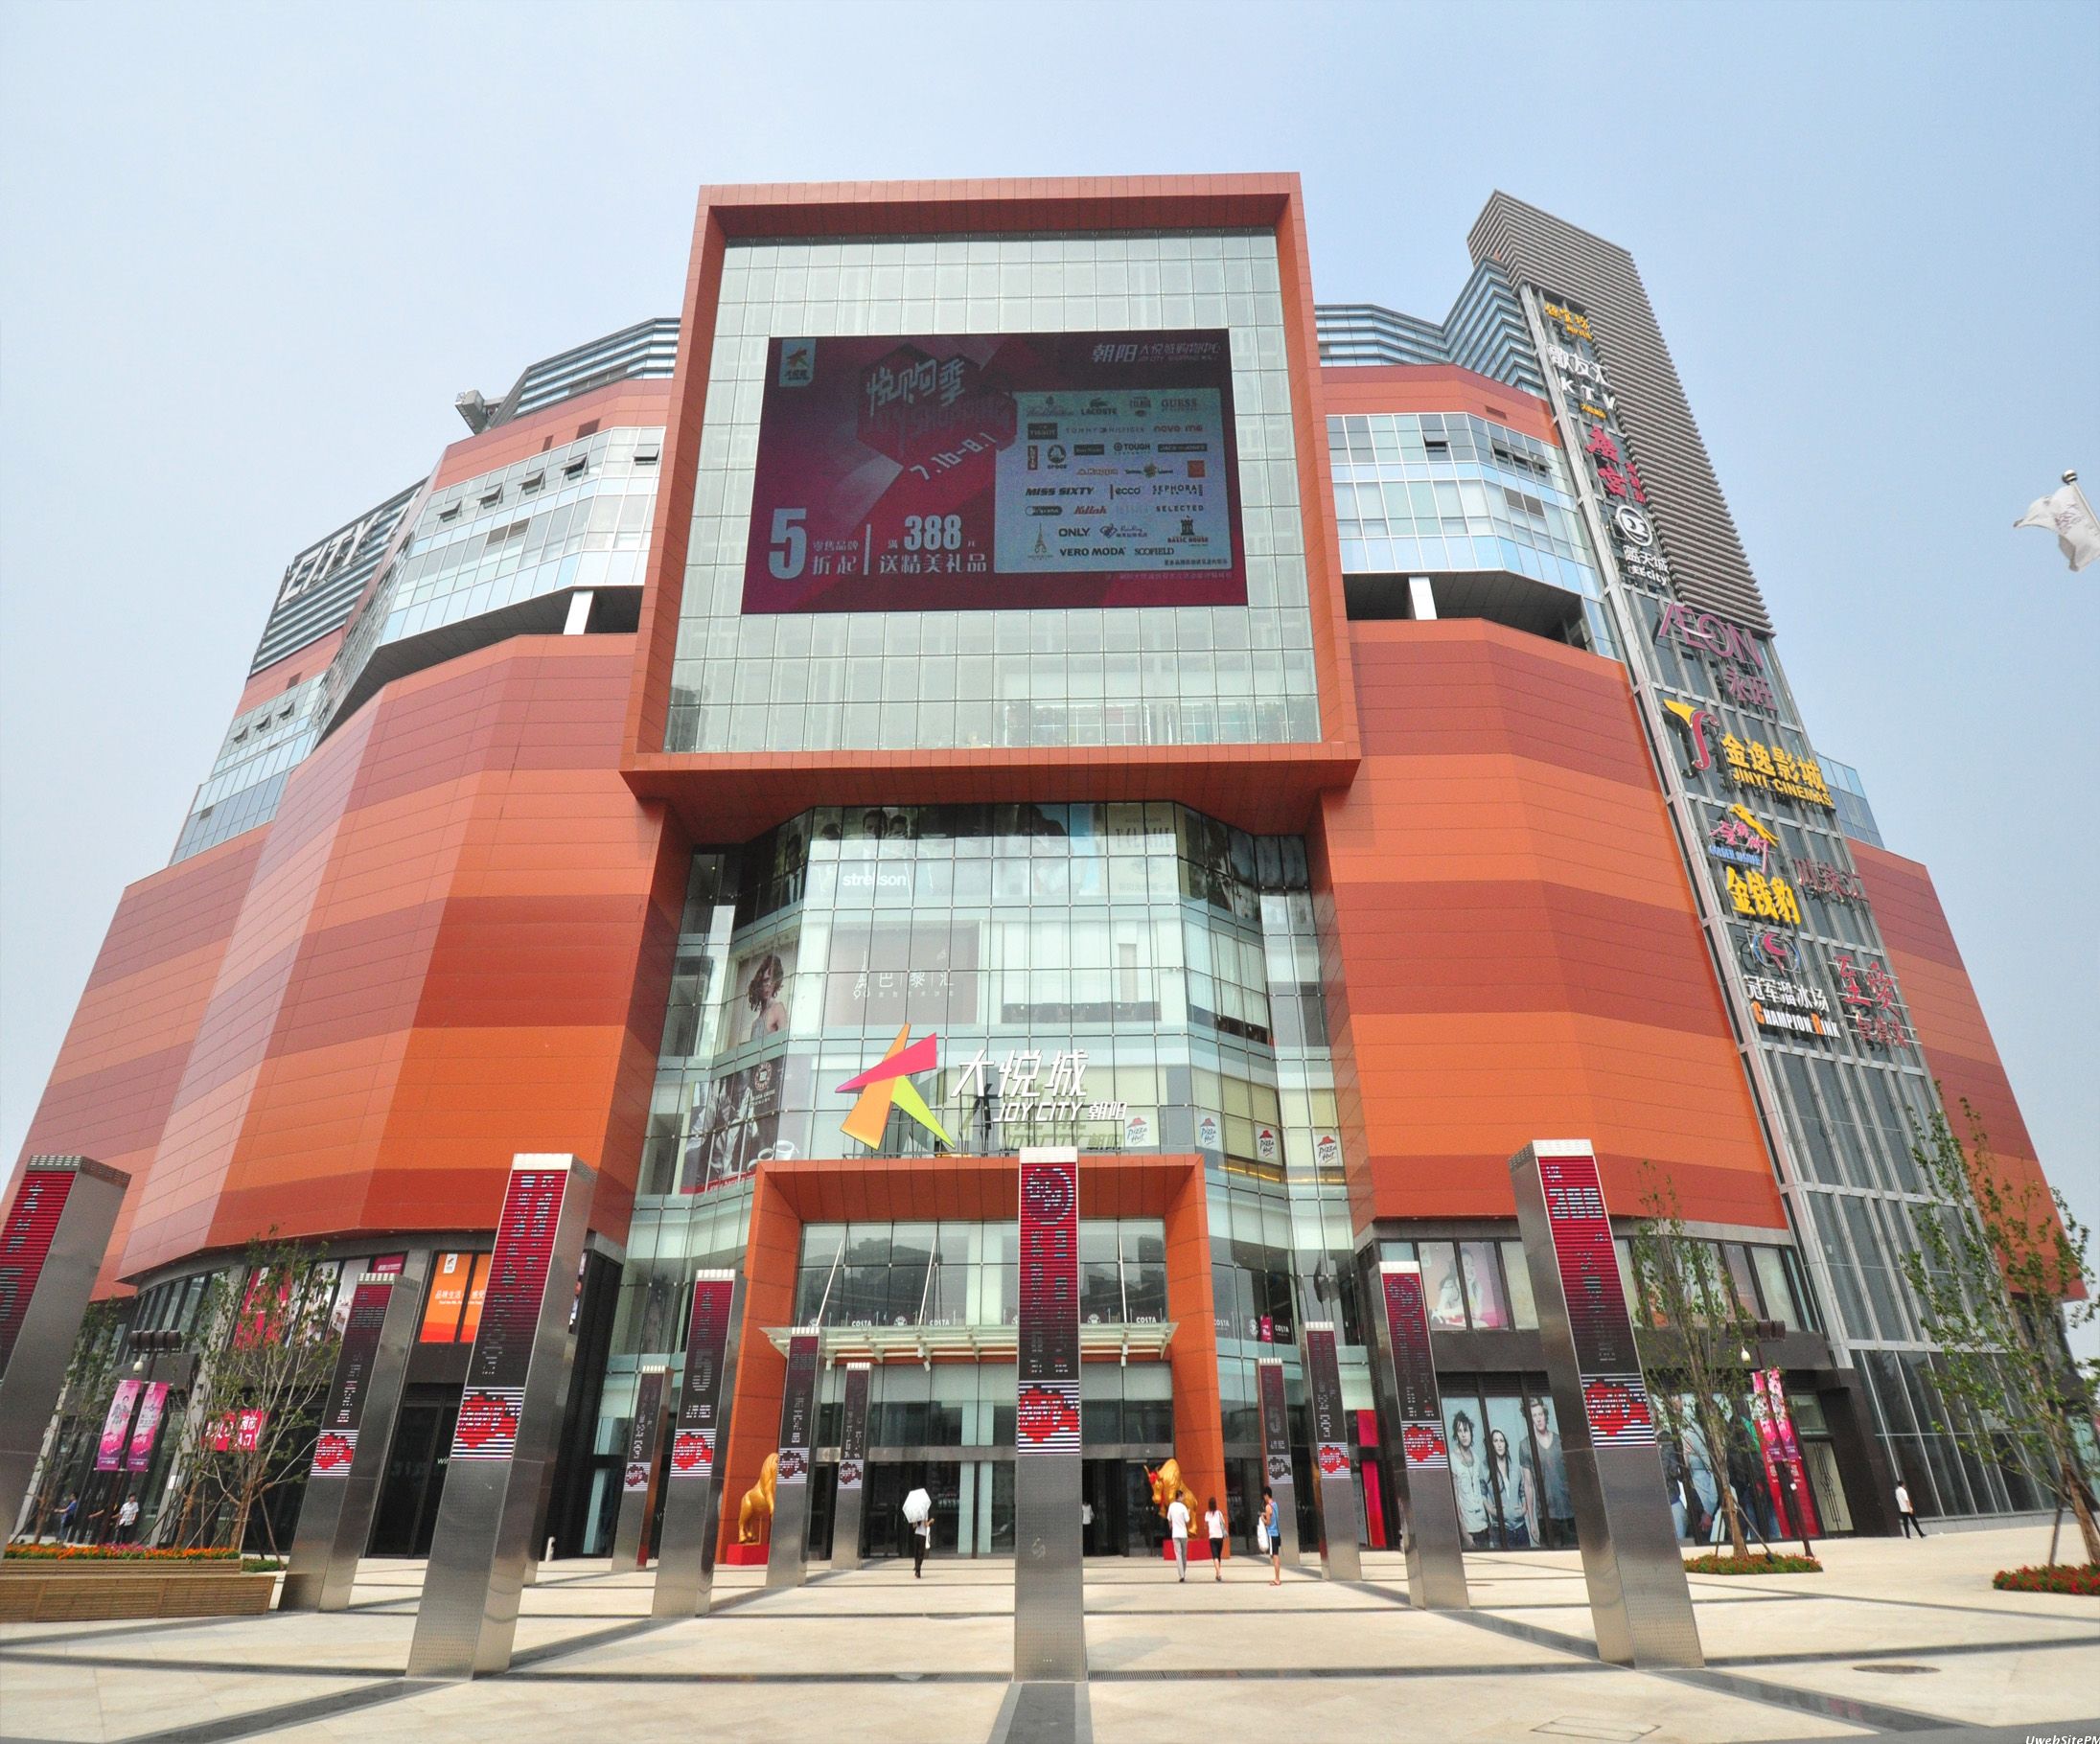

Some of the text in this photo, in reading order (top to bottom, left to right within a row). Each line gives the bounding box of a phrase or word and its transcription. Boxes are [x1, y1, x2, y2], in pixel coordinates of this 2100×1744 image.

[1092, 344, 1139, 362] 朝阳
[1025, 487, 1096, 496] MISS SIXTY
[1115, 487, 1141, 495] ecco
[1155, 504, 1205, 513] SELECTED
[768, 507, 808, 581] 5
[904, 514, 962, 552] 388
[1058, 528, 1091, 538] ONLY
[278, 510, 382, 606] CITY
[1059, 547, 1126, 557] VERO MODA
[1134, 547, 1175, 556] SCOFIELD
[812, 554, 858, 576] 折起
[879, 553, 988, 574] 送精美礼品
[1725, 667, 1779, 712] 永旺
[1720, 732, 1830, 792] 金逸影城
[1732, 767, 1834, 808] JINYI CINEMAS
[1726, 865, 1802, 927] 金钱豹
[1742, 975, 1831, 1013] 冠军溜冰场
[1751, 1001, 1812, 1032] CHAMPION
[1811, 1012, 1841, 1039] RINK
[950, 1049, 1090, 1098] 大悦城
[993, 1101, 1128, 1123] JOY CITY 朝阳
[1548, 1186, 1604, 1220] 388
[1135, 1316, 1157, 1324] COSTA
[1274, 1323, 1290, 1333] COSTA
